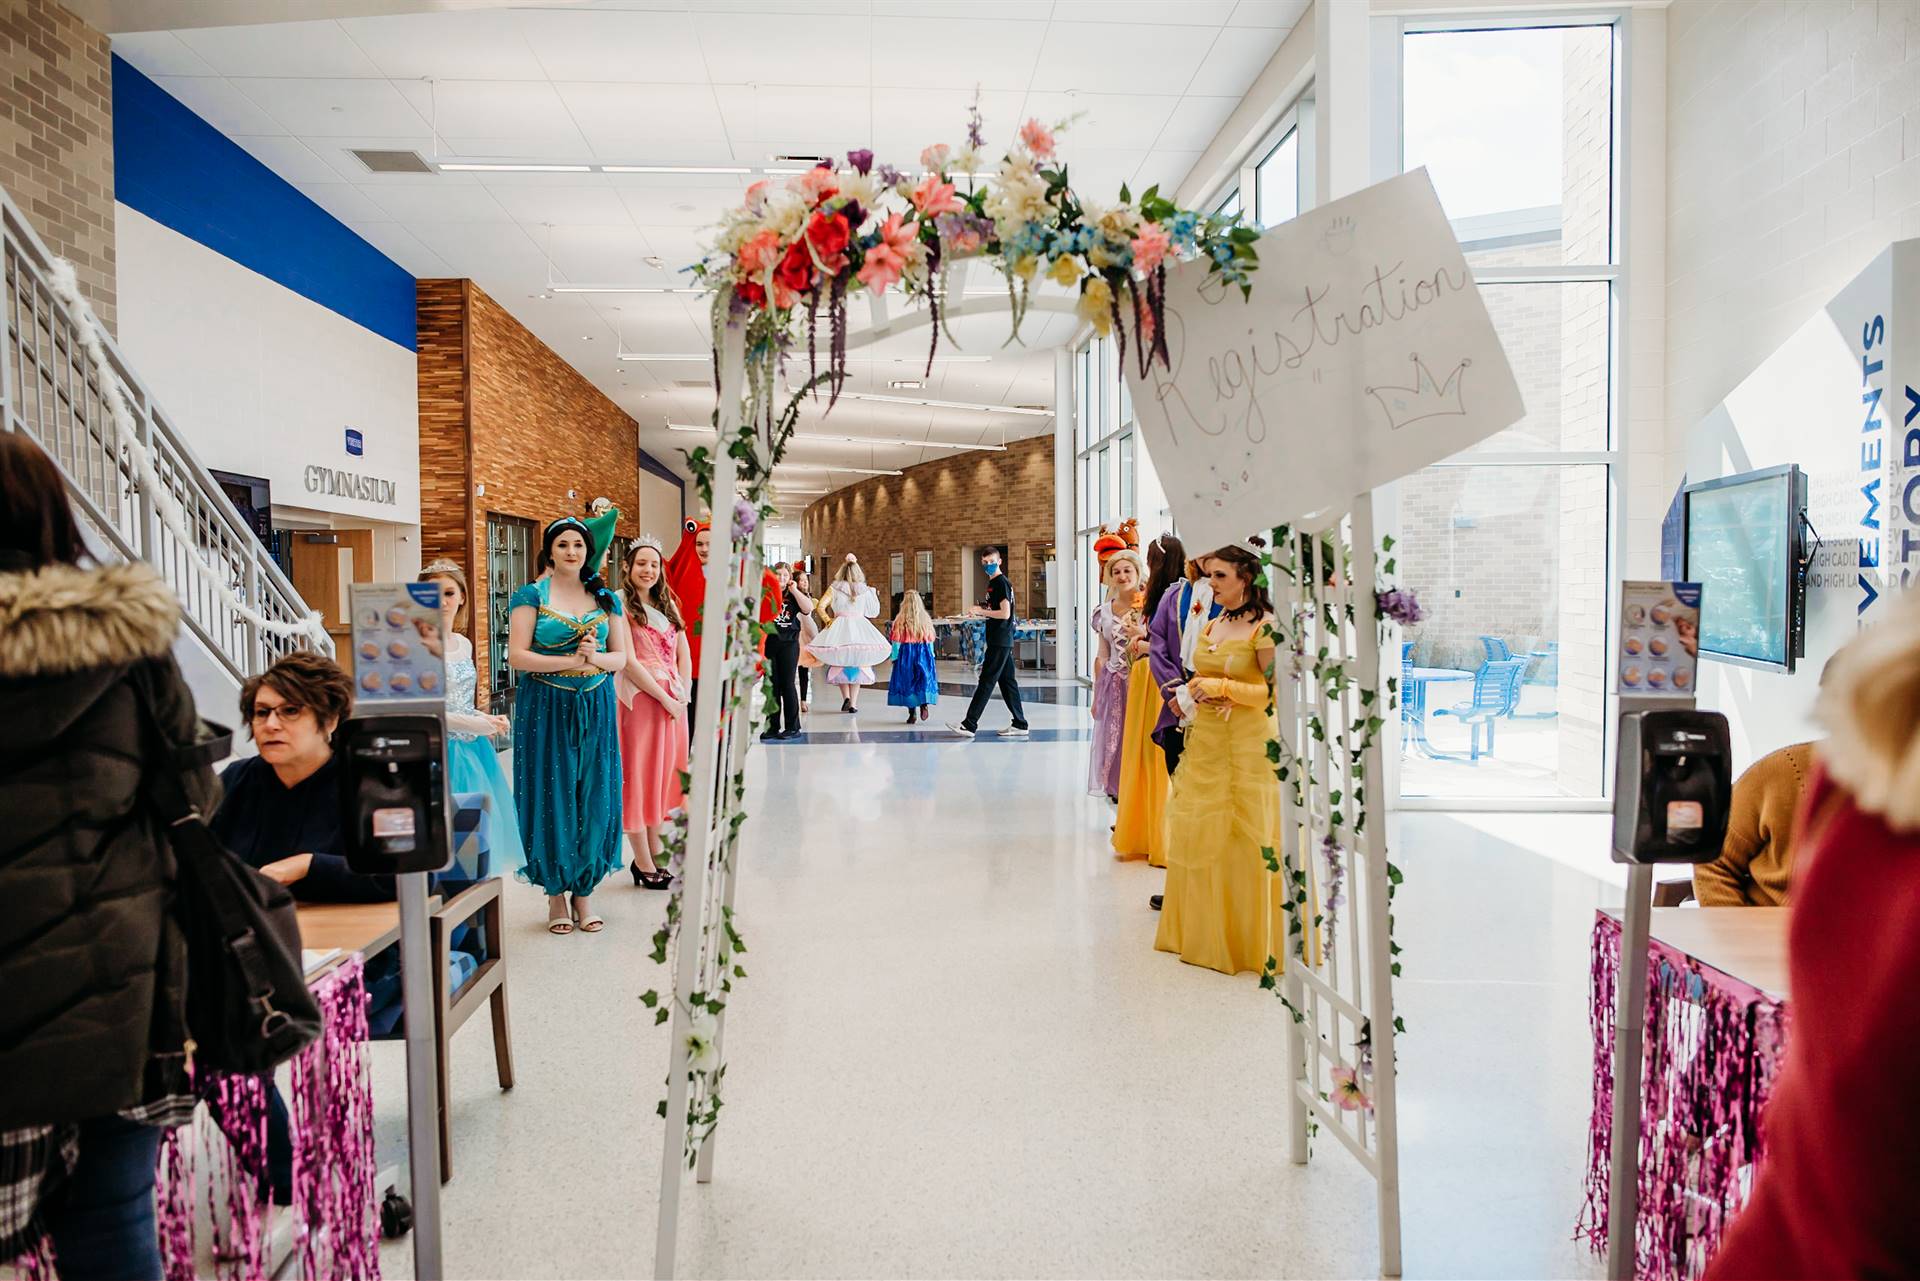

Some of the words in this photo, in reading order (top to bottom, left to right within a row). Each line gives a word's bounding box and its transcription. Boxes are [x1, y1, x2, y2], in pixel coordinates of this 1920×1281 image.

[1129, 260, 1466, 445] Registration
[304, 465, 397, 505] GYMNASIUM
[1824, 573, 1845, 588] HIGH
